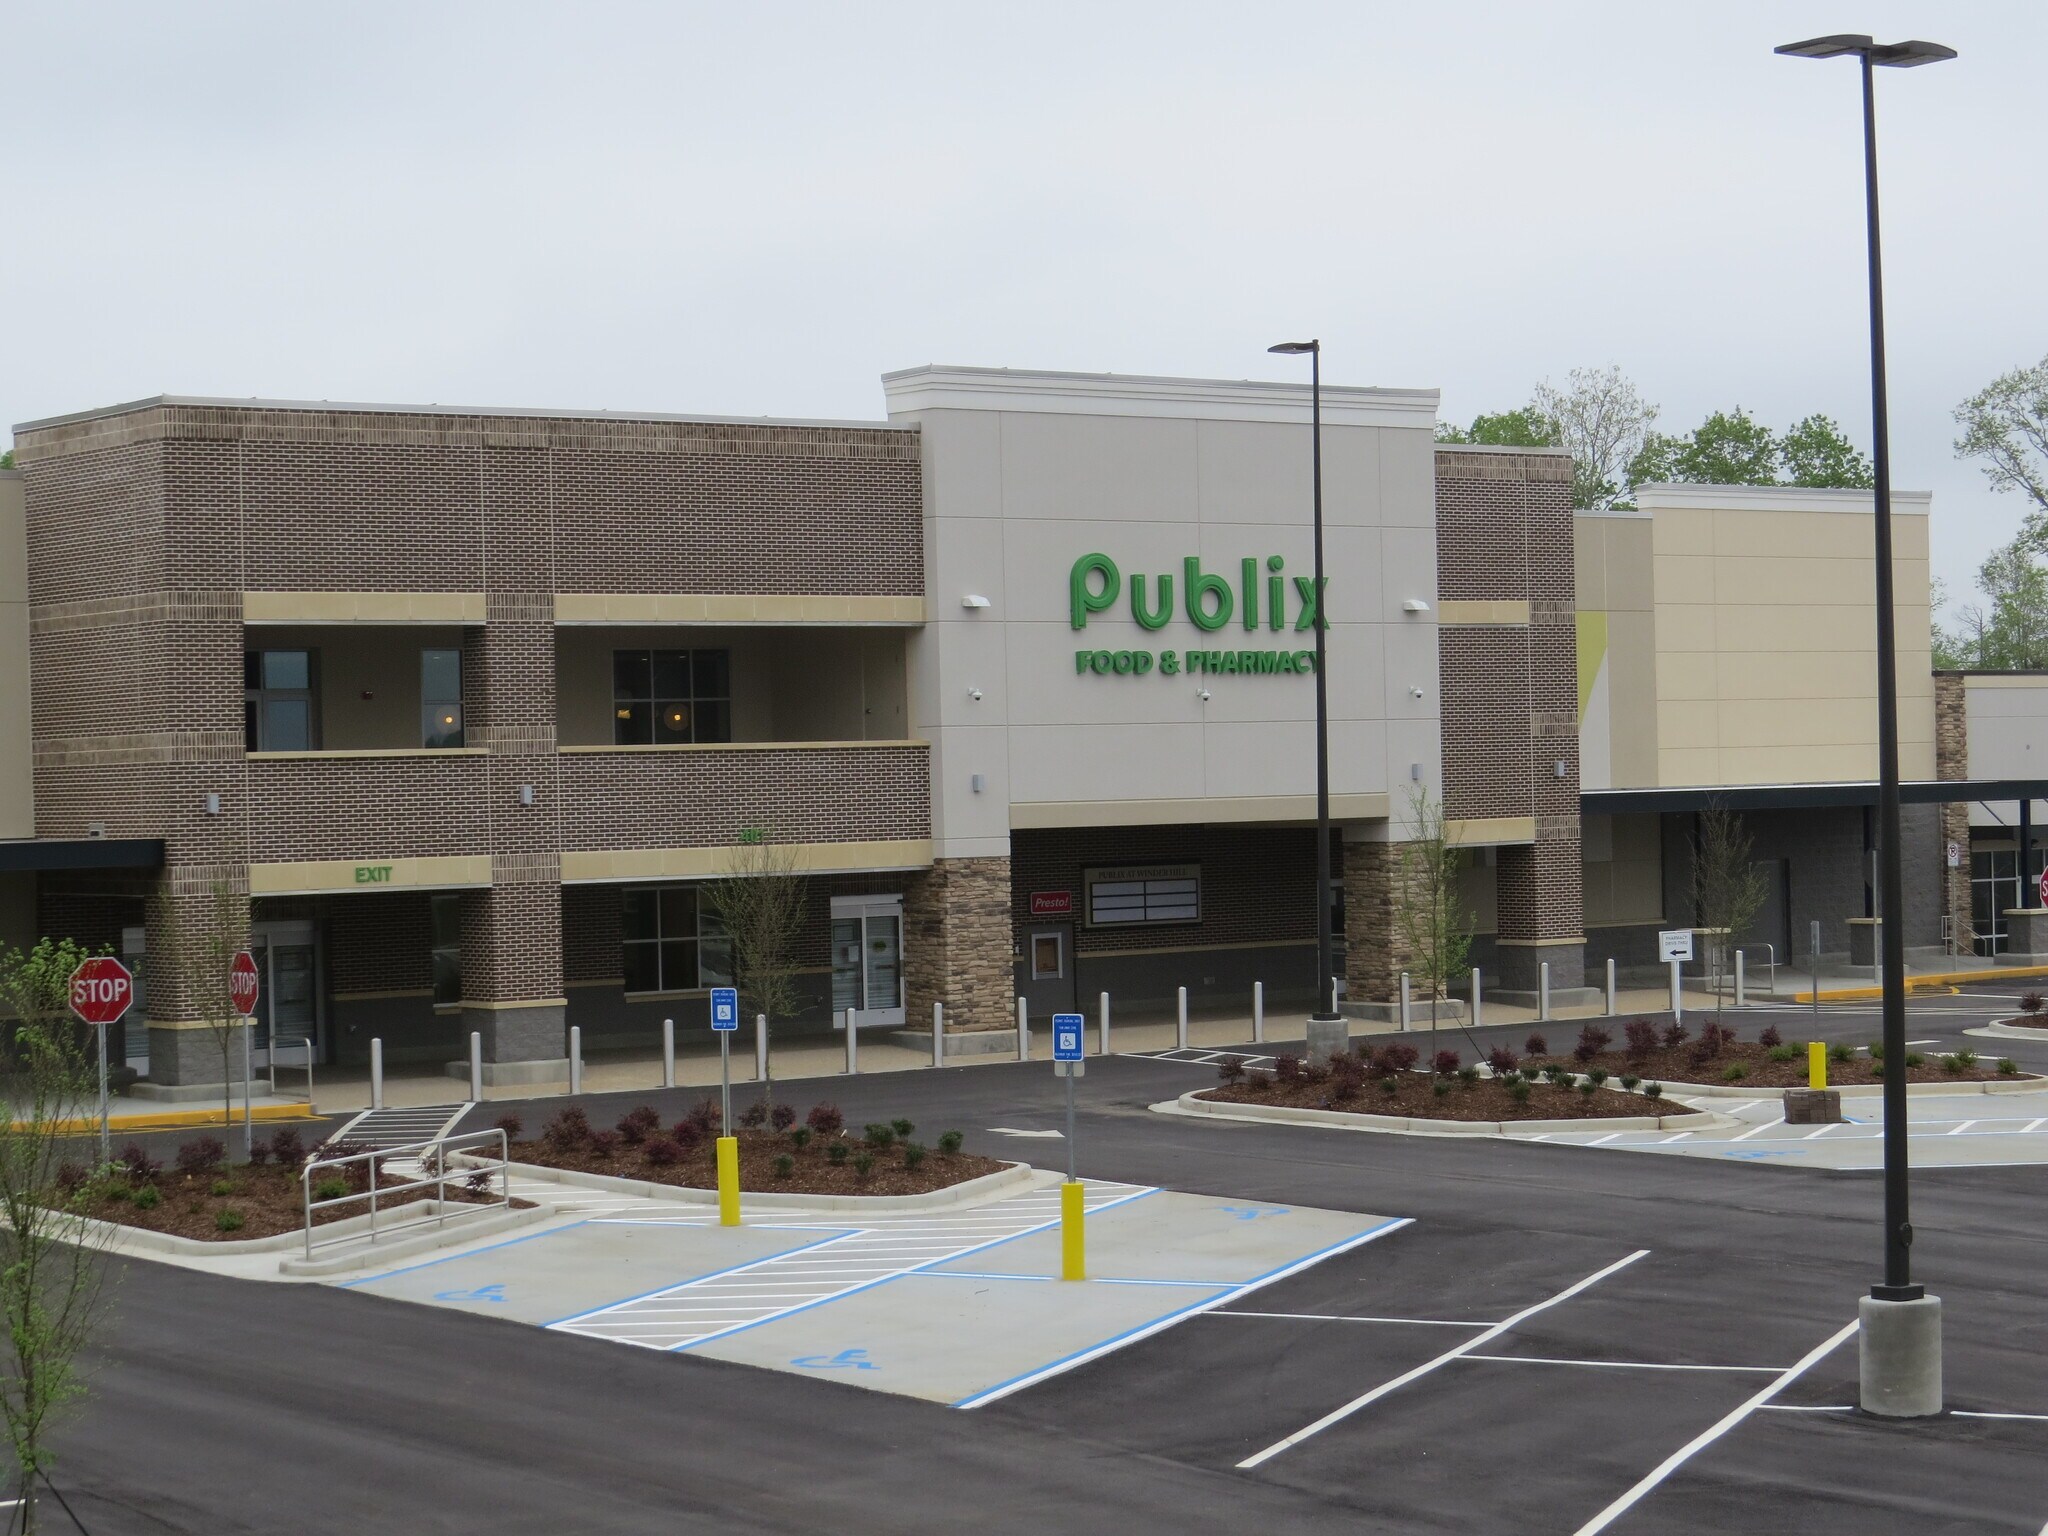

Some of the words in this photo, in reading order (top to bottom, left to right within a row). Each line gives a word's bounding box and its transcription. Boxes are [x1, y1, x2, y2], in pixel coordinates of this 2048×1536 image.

[1070, 553, 1330, 630] Publix
[1076, 650, 1153, 674] FOOD
[1159, 650, 1181, 674] &
[355, 866, 392, 883] EXIT
[1035, 896, 1069, 908] Presto!
[74, 978, 127, 1003] STOP
[231, 972, 256, 994] STOP
